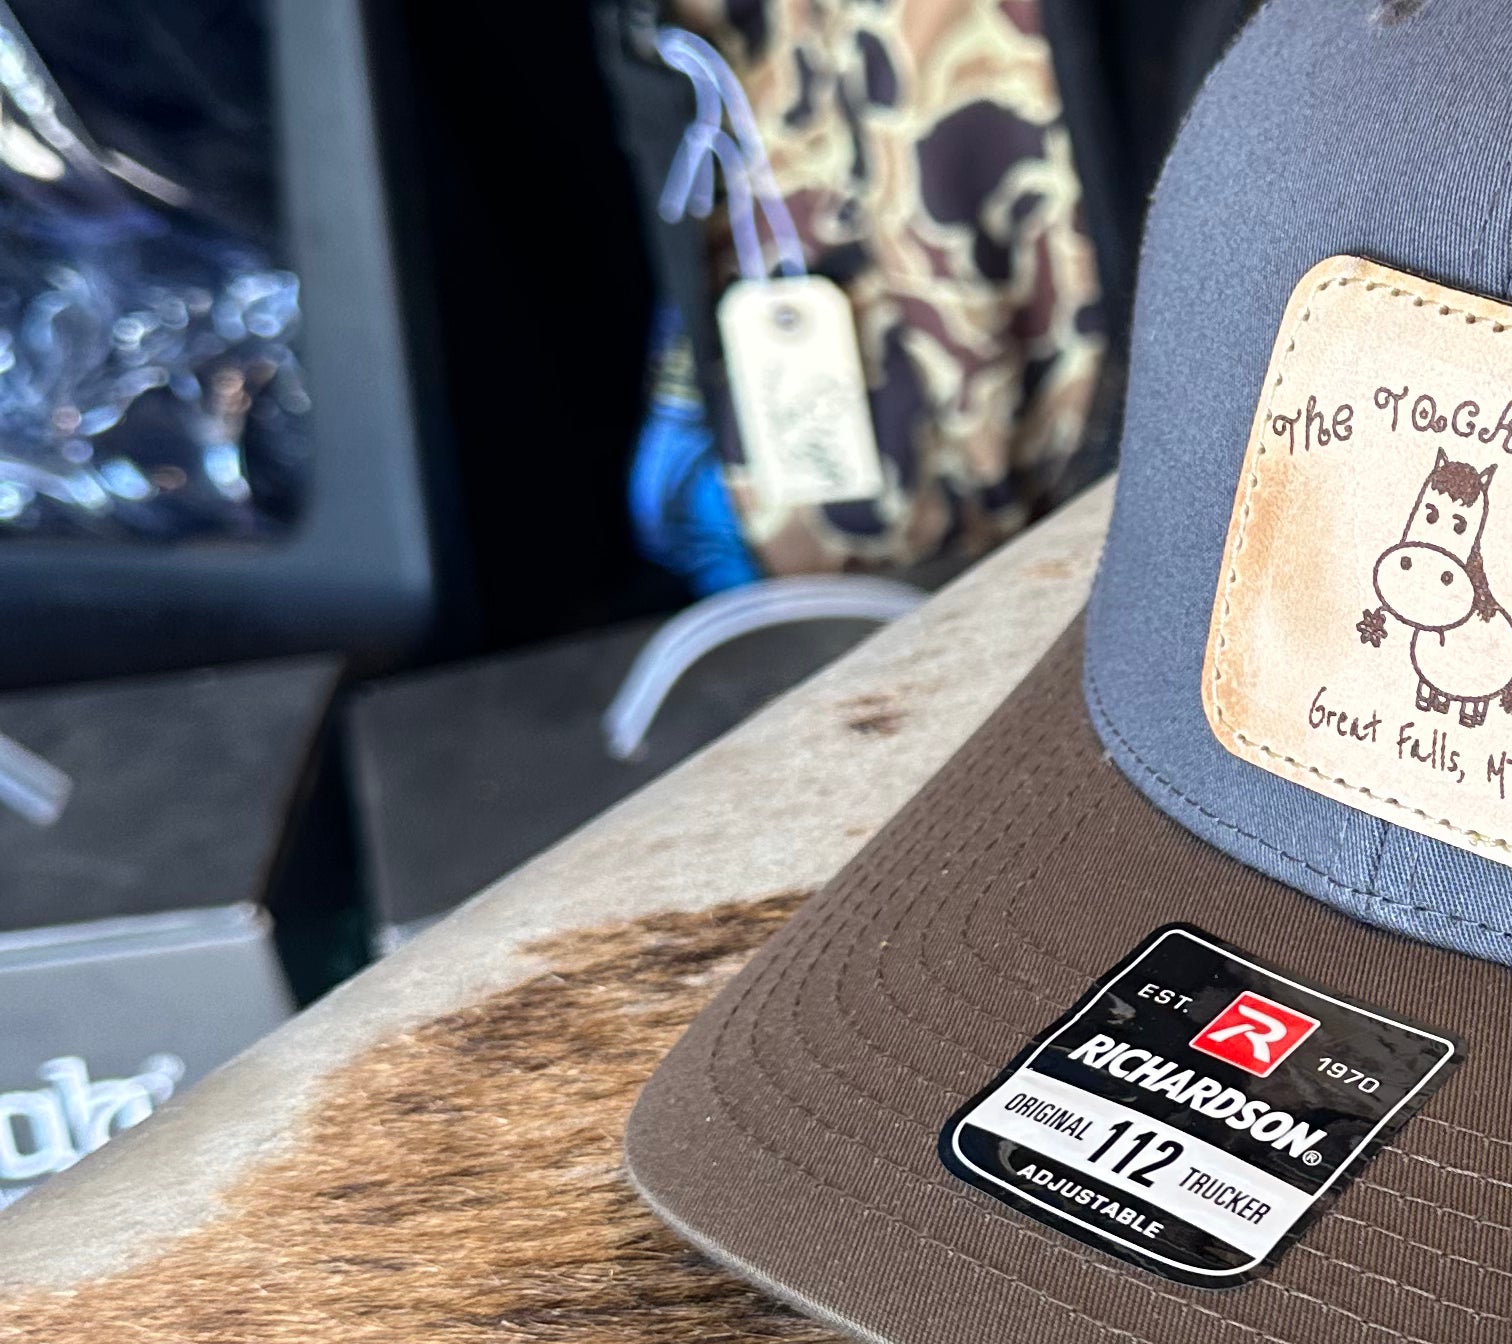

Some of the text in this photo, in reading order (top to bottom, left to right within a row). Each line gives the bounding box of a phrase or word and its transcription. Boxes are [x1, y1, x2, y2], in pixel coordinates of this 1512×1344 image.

[1272, 395, 1354, 455] The
[1309, 686, 1382, 742] Great
[1396, 721, 1465, 783] Falls,
[1137, 982, 1383, 1094] EST. 1970
[1003, 1092, 1272, 1225] ORIGINAL 112 TRUCKER
[1016, 1162, 1164, 1239] ADJUSTABLE
